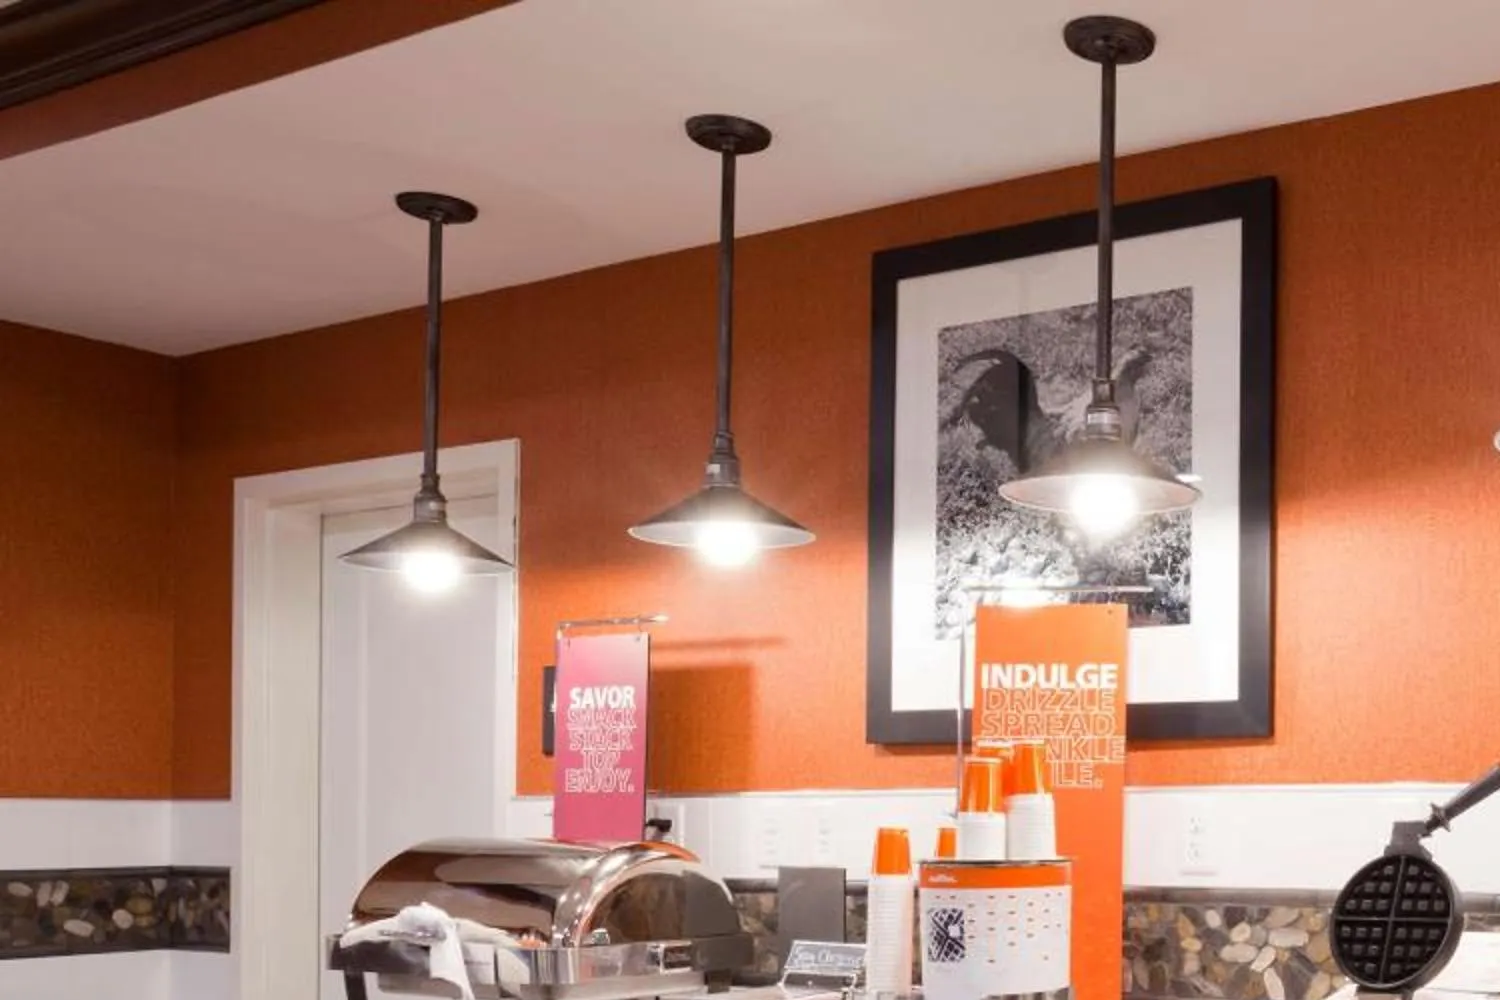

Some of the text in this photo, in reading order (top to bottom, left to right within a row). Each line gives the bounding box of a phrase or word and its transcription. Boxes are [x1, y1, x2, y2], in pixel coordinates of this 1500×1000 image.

[981, 663, 1118, 689] INDULGE
[569, 686, 636, 709] SAVOR
[984, 688, 1115, 712] DRIZZLE
[981, 711, 1116, 737] SPREAD
